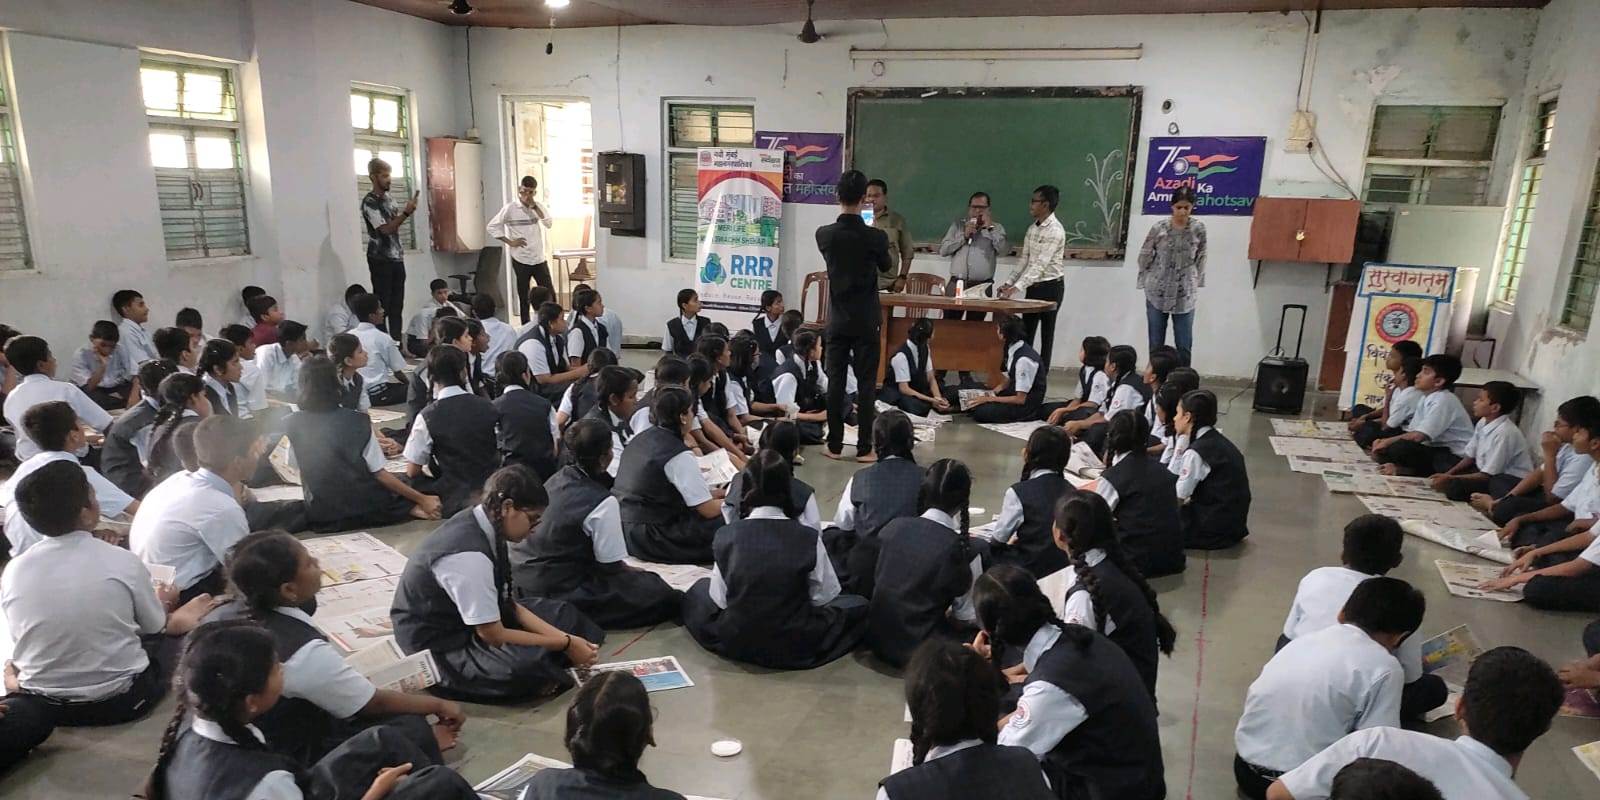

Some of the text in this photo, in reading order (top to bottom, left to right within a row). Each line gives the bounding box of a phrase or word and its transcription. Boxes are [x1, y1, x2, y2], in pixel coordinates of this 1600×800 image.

[1154, 177, 1214, 194] Azadi Ka
[1147, 192, 1254, 207] Amr ahotsav
[731, 255, 773, 277] RRR
[730, 277, 772, 290] CENTRE
